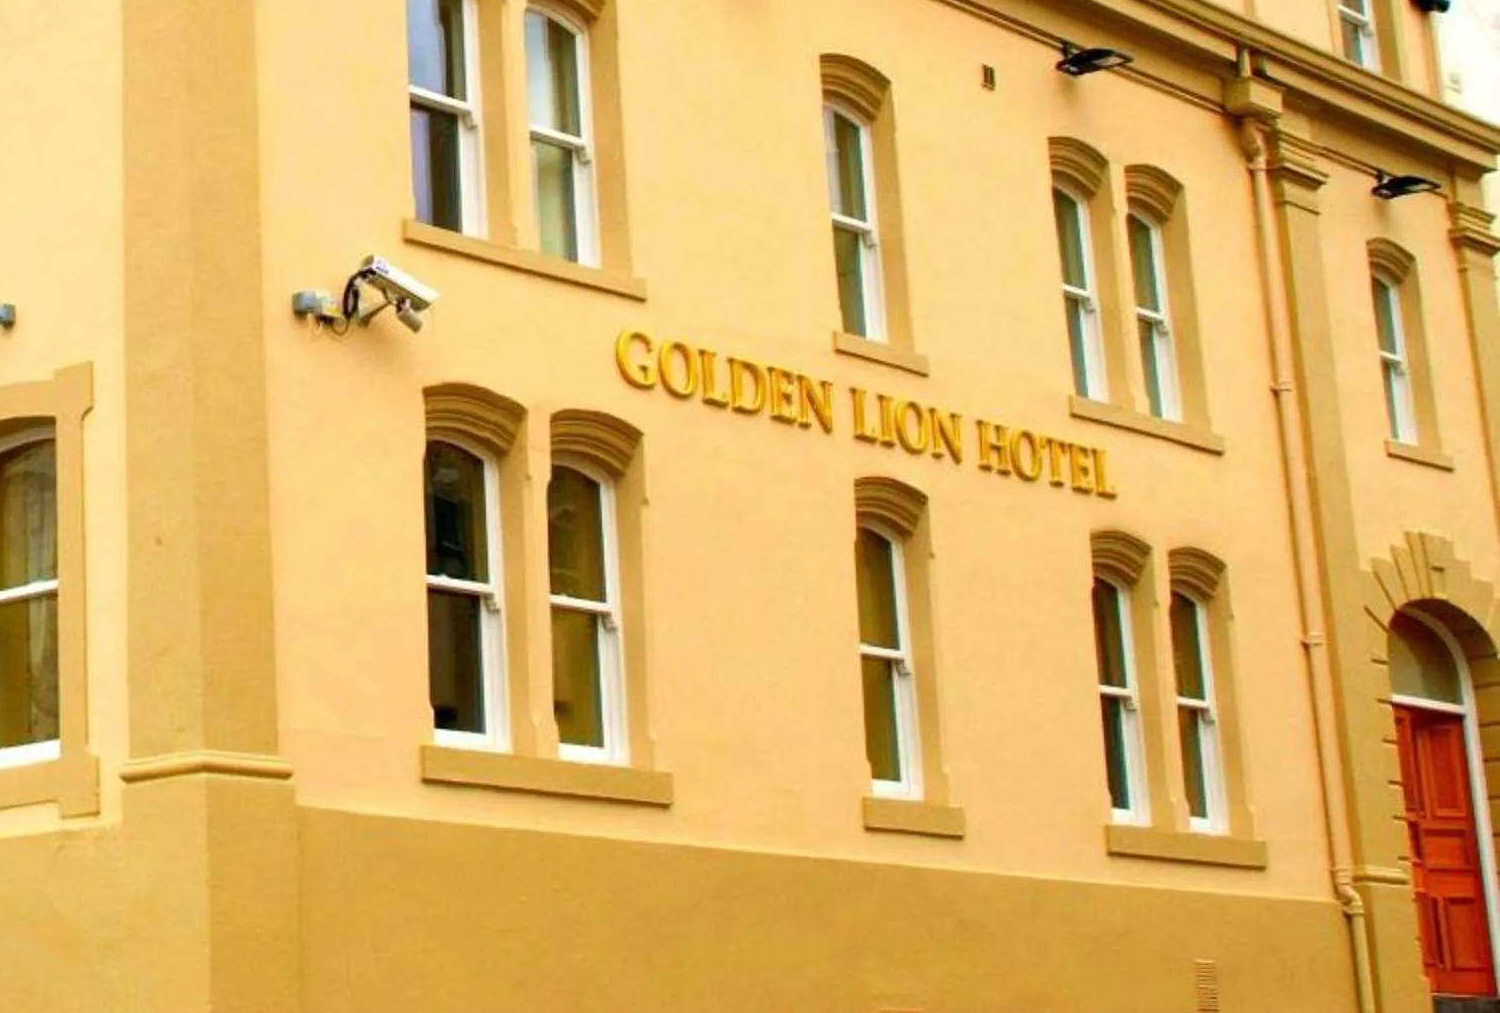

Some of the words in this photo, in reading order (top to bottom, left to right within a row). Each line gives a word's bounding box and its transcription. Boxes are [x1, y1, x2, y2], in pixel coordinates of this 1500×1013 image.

[615, 330, 833, 433] GOLDEN
[849, 386, 963, 464] LION
[975, 419, 1117, 500] HOTEL
